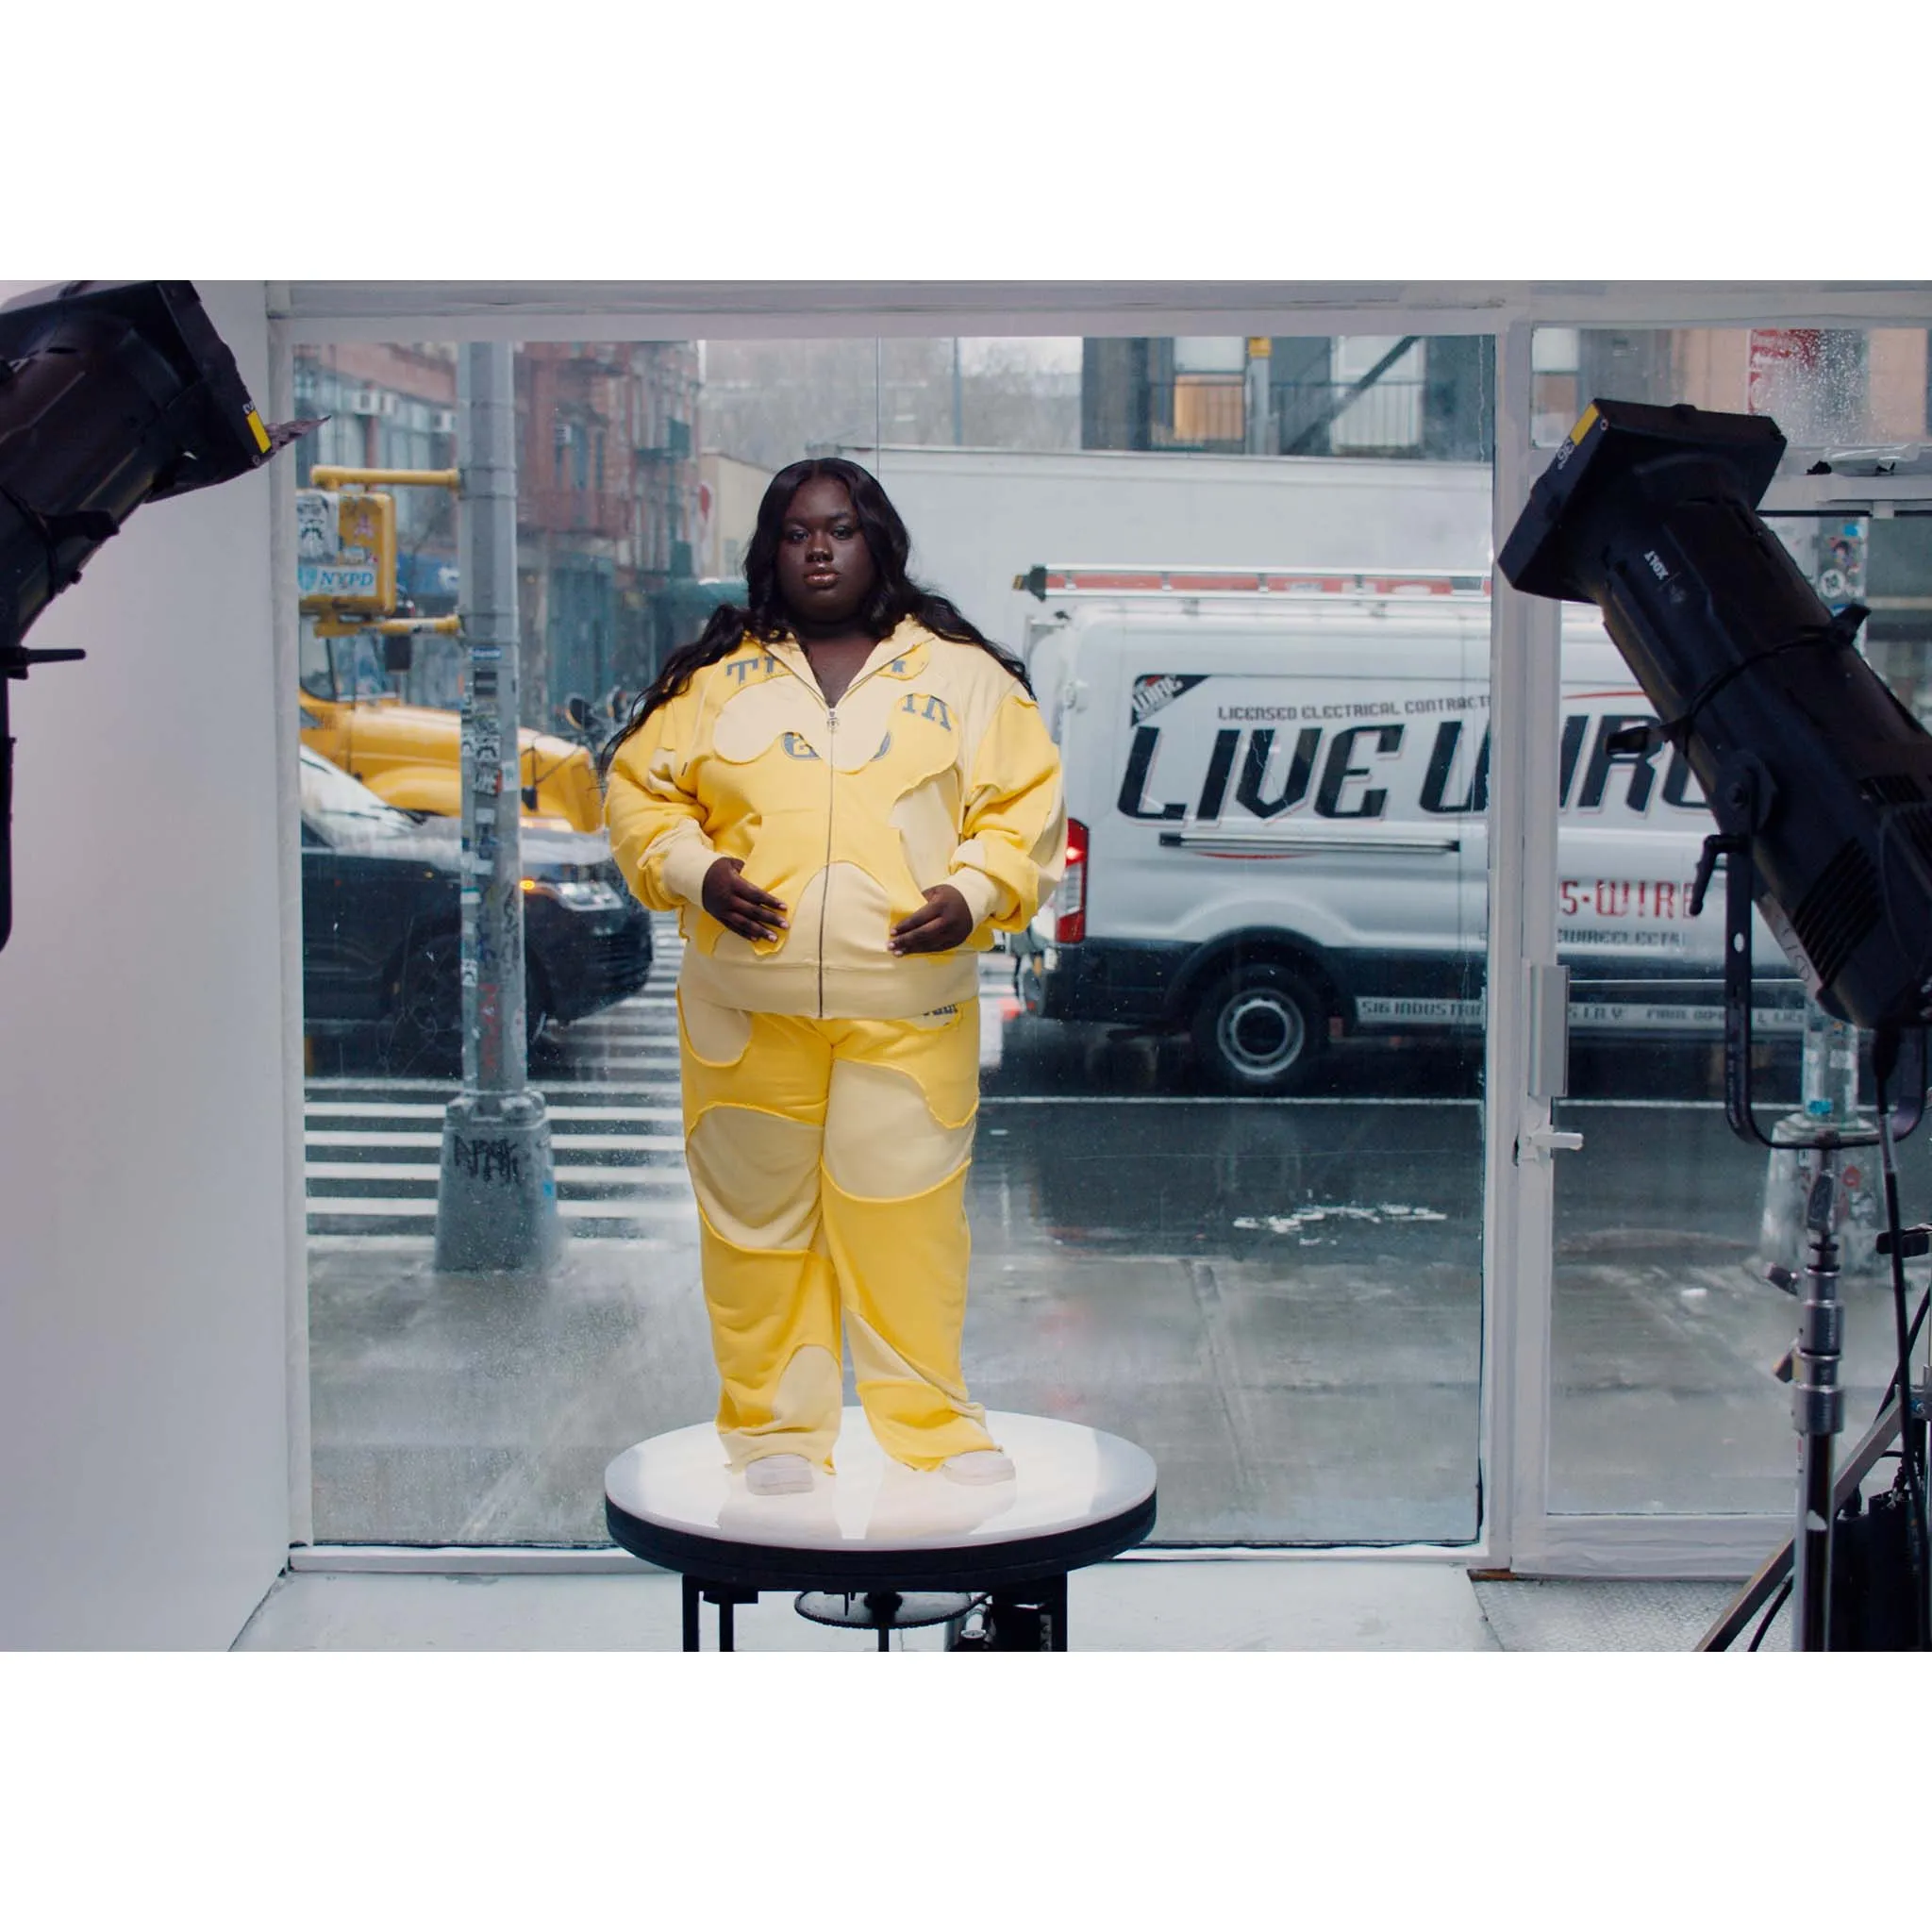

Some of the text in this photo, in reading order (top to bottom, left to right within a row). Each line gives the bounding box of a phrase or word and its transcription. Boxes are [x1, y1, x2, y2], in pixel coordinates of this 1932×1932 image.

[321, 570, 375, 587] NYPD
[1218, 705, 1297, 722] LICENSED
[1302, 700, 1401, 719] ELECTRICAL
[1117, 723, 1406, 821] LIVE
